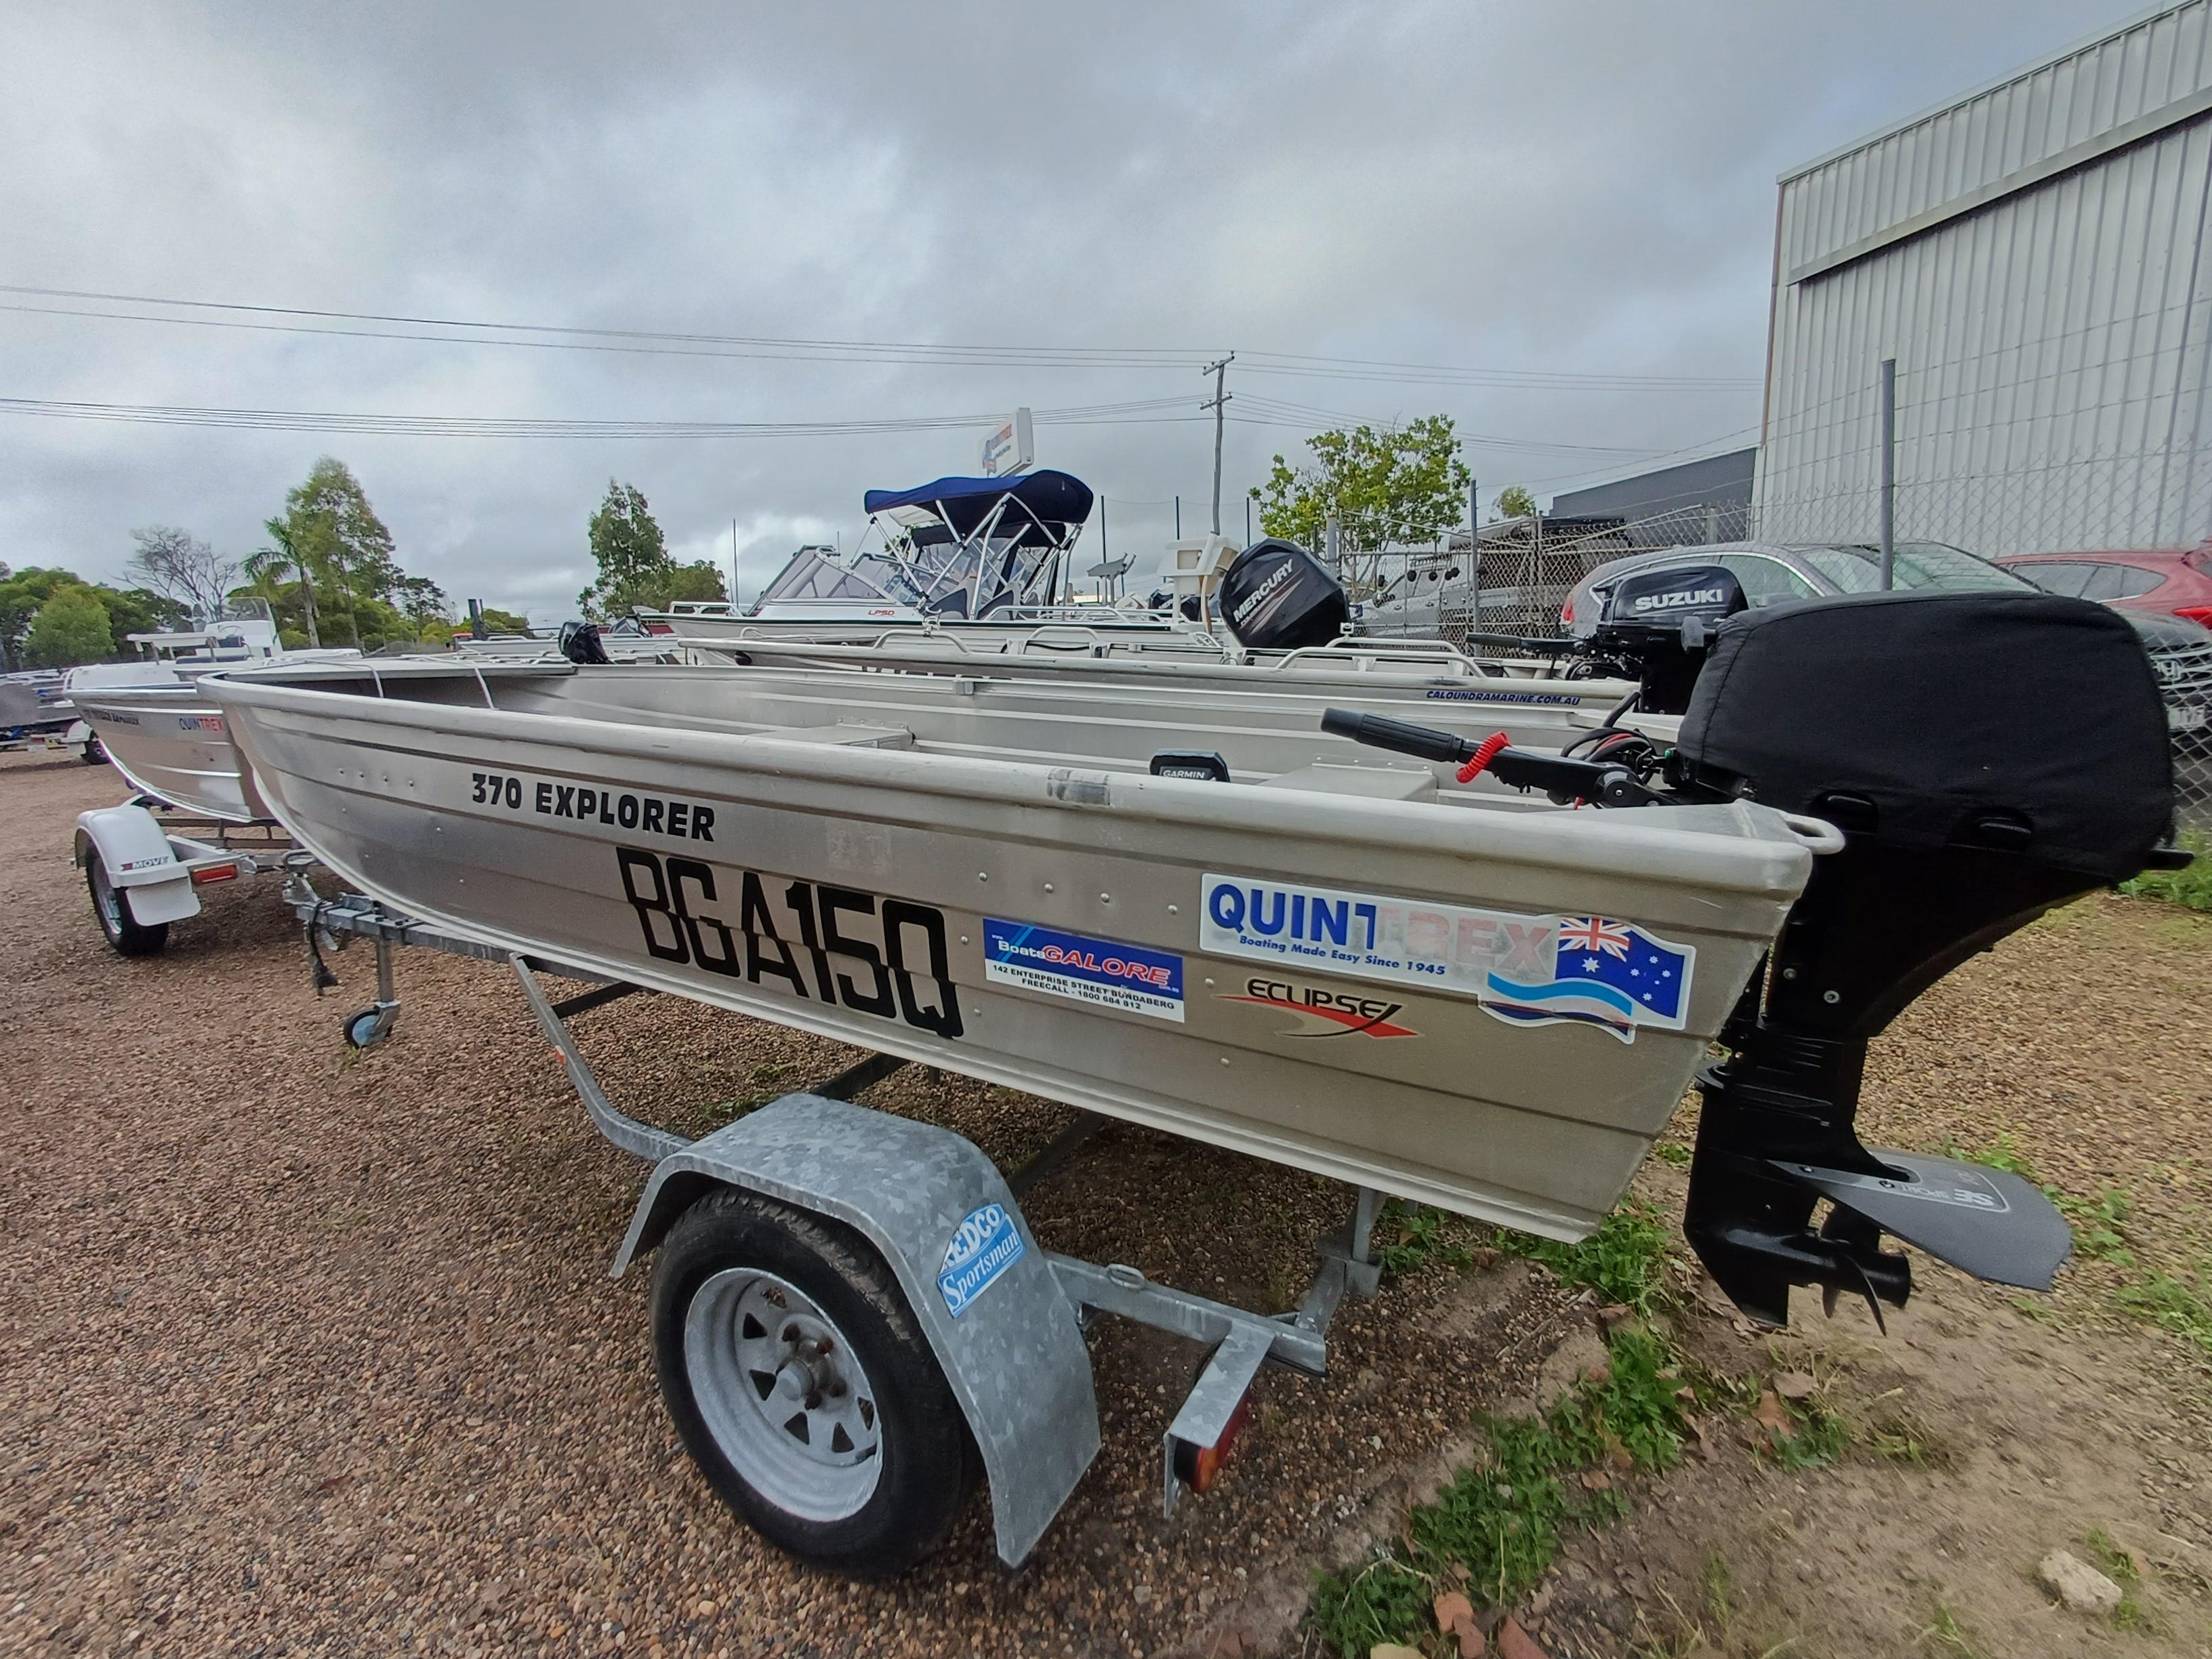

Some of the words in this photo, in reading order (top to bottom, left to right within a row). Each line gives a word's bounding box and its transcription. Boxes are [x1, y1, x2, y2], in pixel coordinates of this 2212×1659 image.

[1233, 558, 1292, 622] MERCURY
[1635, 589, 1723, 611] SUZUKI
[1426, 691, 1580, 705] CALOUNDRAMARINE.COM.AU
[179, 717, 224, 732] QUINTREX
[1163, 770, 1205, 779] GARMIN
[472, 773, 522, 809] 370
[536, 781, 715, 842] EXPLORER
[615, 846, 964, 1040] BGA15Q
[1240, 935, 1286, 953] Boating
[1291, 943, 1326, 957] Made
[1331, 949, 1360, 964] Easy
[1364, 954, 1399, 968] Since
[1407, 961, 1446, 975] 1945
[993, 964, 1008, 974] 142
[1010, 968, 1068, 987] ENTERPRISE
[1071, 981, 1108, 995] STREET
[1111, 989, 1174, 1009] BUNDABERG
[1022, 978, 1069, 994] FREECALL
[1078, 990, 1100, 1000] 1800
[1247, 978, 1389, 1019] ECLIPSE
[943, 1231, 1018, 1309] Sportsman
